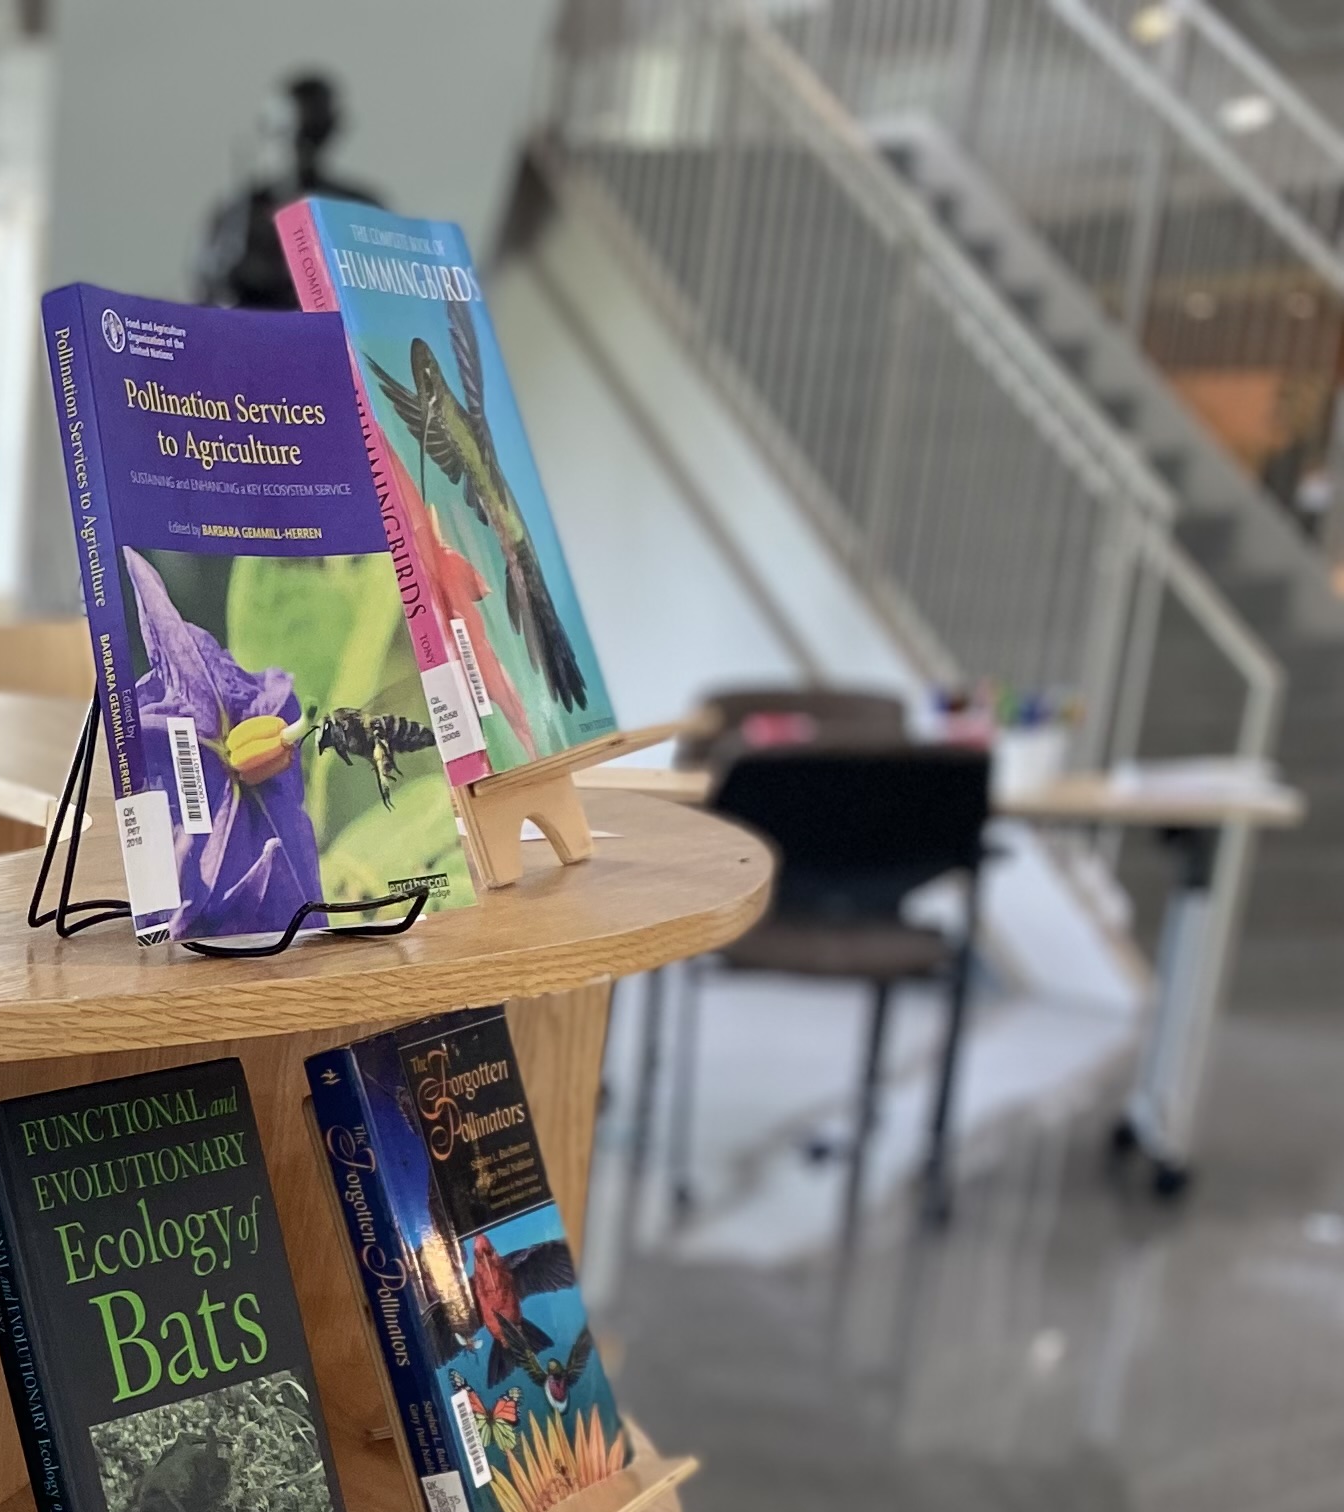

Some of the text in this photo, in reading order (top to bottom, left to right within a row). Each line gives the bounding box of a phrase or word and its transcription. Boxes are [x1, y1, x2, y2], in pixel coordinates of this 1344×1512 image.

[332, 248, 483, 302] HUMMINGBIRDS
[124, 378, 326, 425] Pollination Services
[55, 326, 106, 608] Pollination Services to Agriculture
[157, 430, 303, 471] to Agriculture
[416, 1050, 509, 1120] Forgotten
[19, 1086, 237, 1156] FUNCTIONAL and
[430, 1097, 525, 1161] Pollinators
[32, 1132, 247, 1211] EVOLUTIONARY
[54, 1195, 261, 1285] Ecology of
[89, 1289, 268, 1403] Bats
